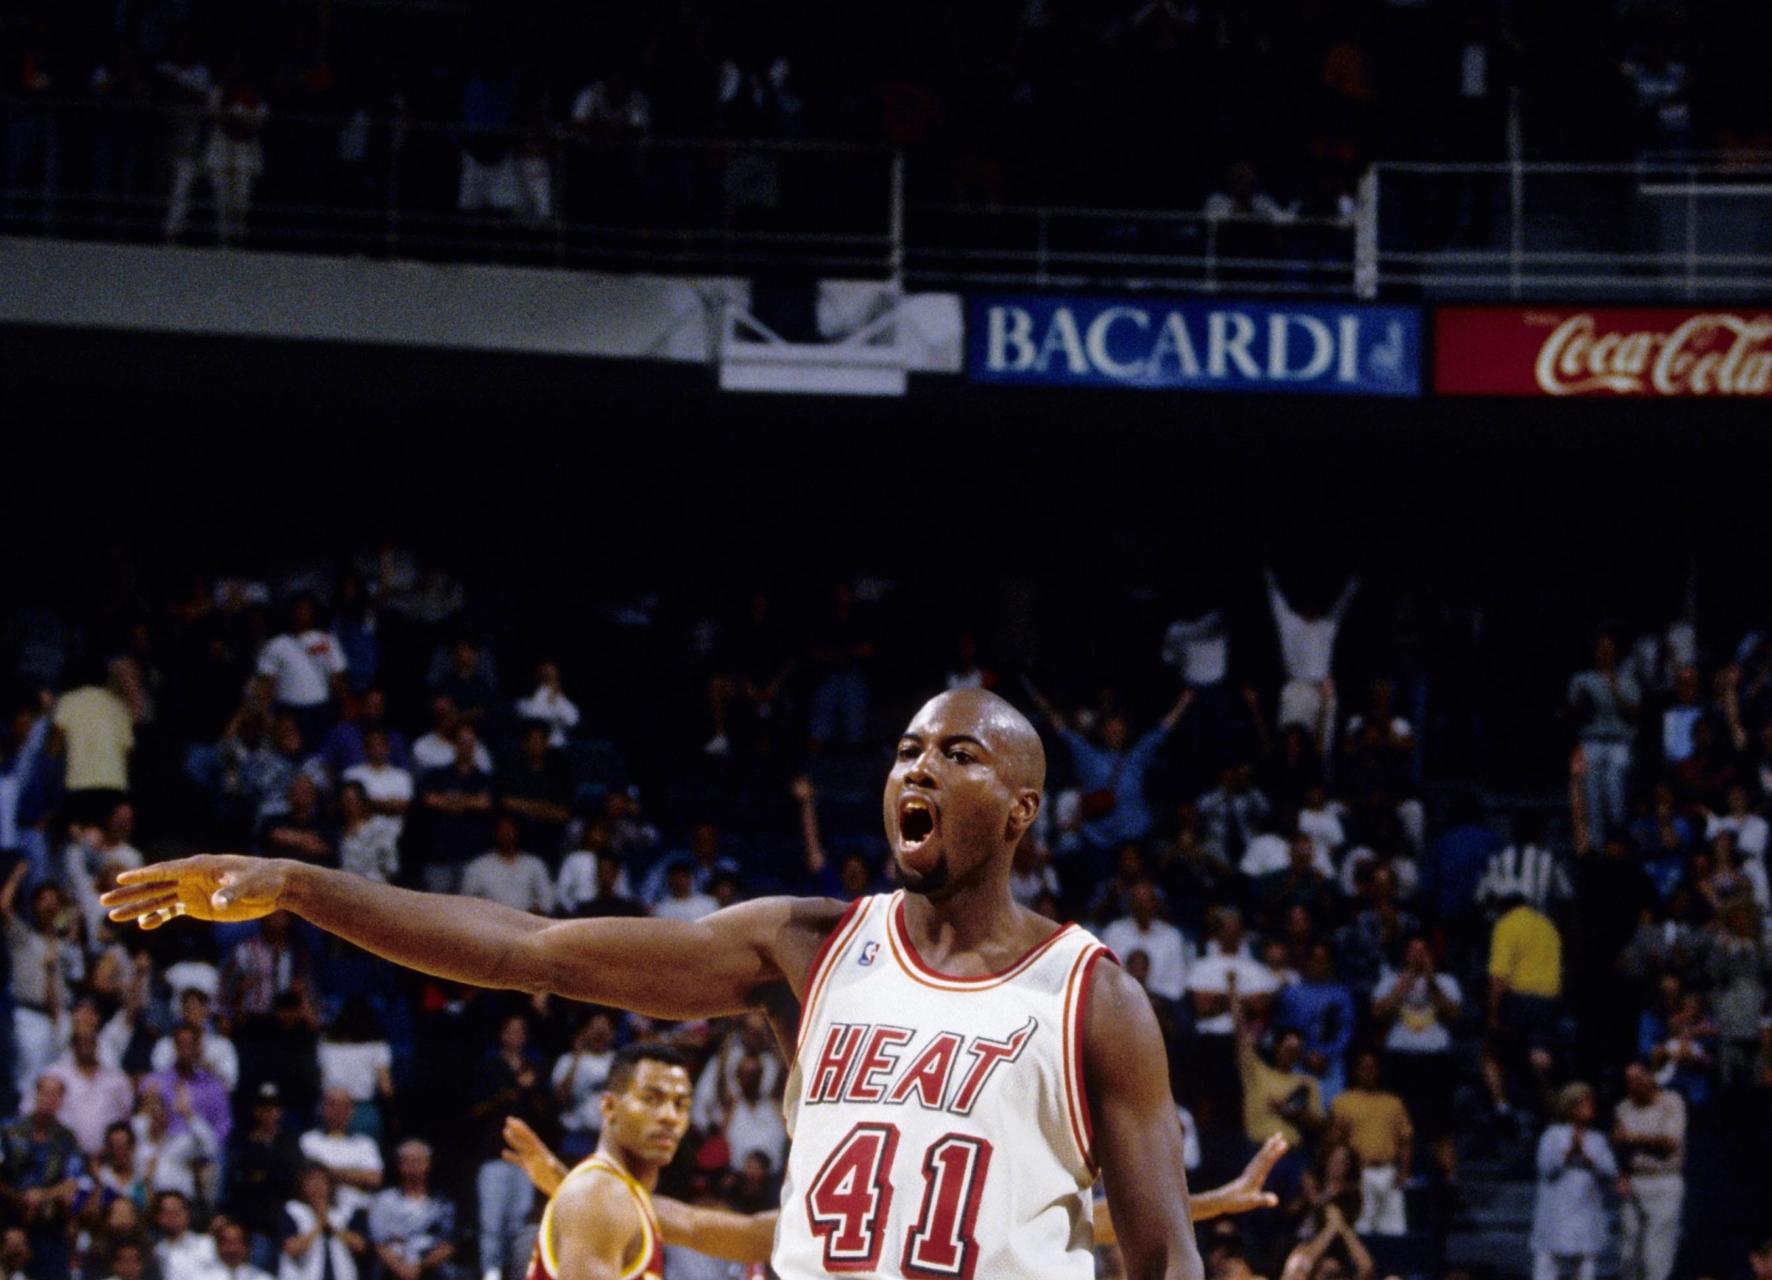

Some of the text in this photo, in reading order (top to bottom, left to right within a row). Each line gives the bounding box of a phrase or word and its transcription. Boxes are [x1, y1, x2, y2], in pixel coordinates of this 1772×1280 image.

[986, 305, 1359, 382] BACARDI
[1535, 313, 1772, 396] Coca-Cola
[805, 1015, 1037, 1117] HEAT
